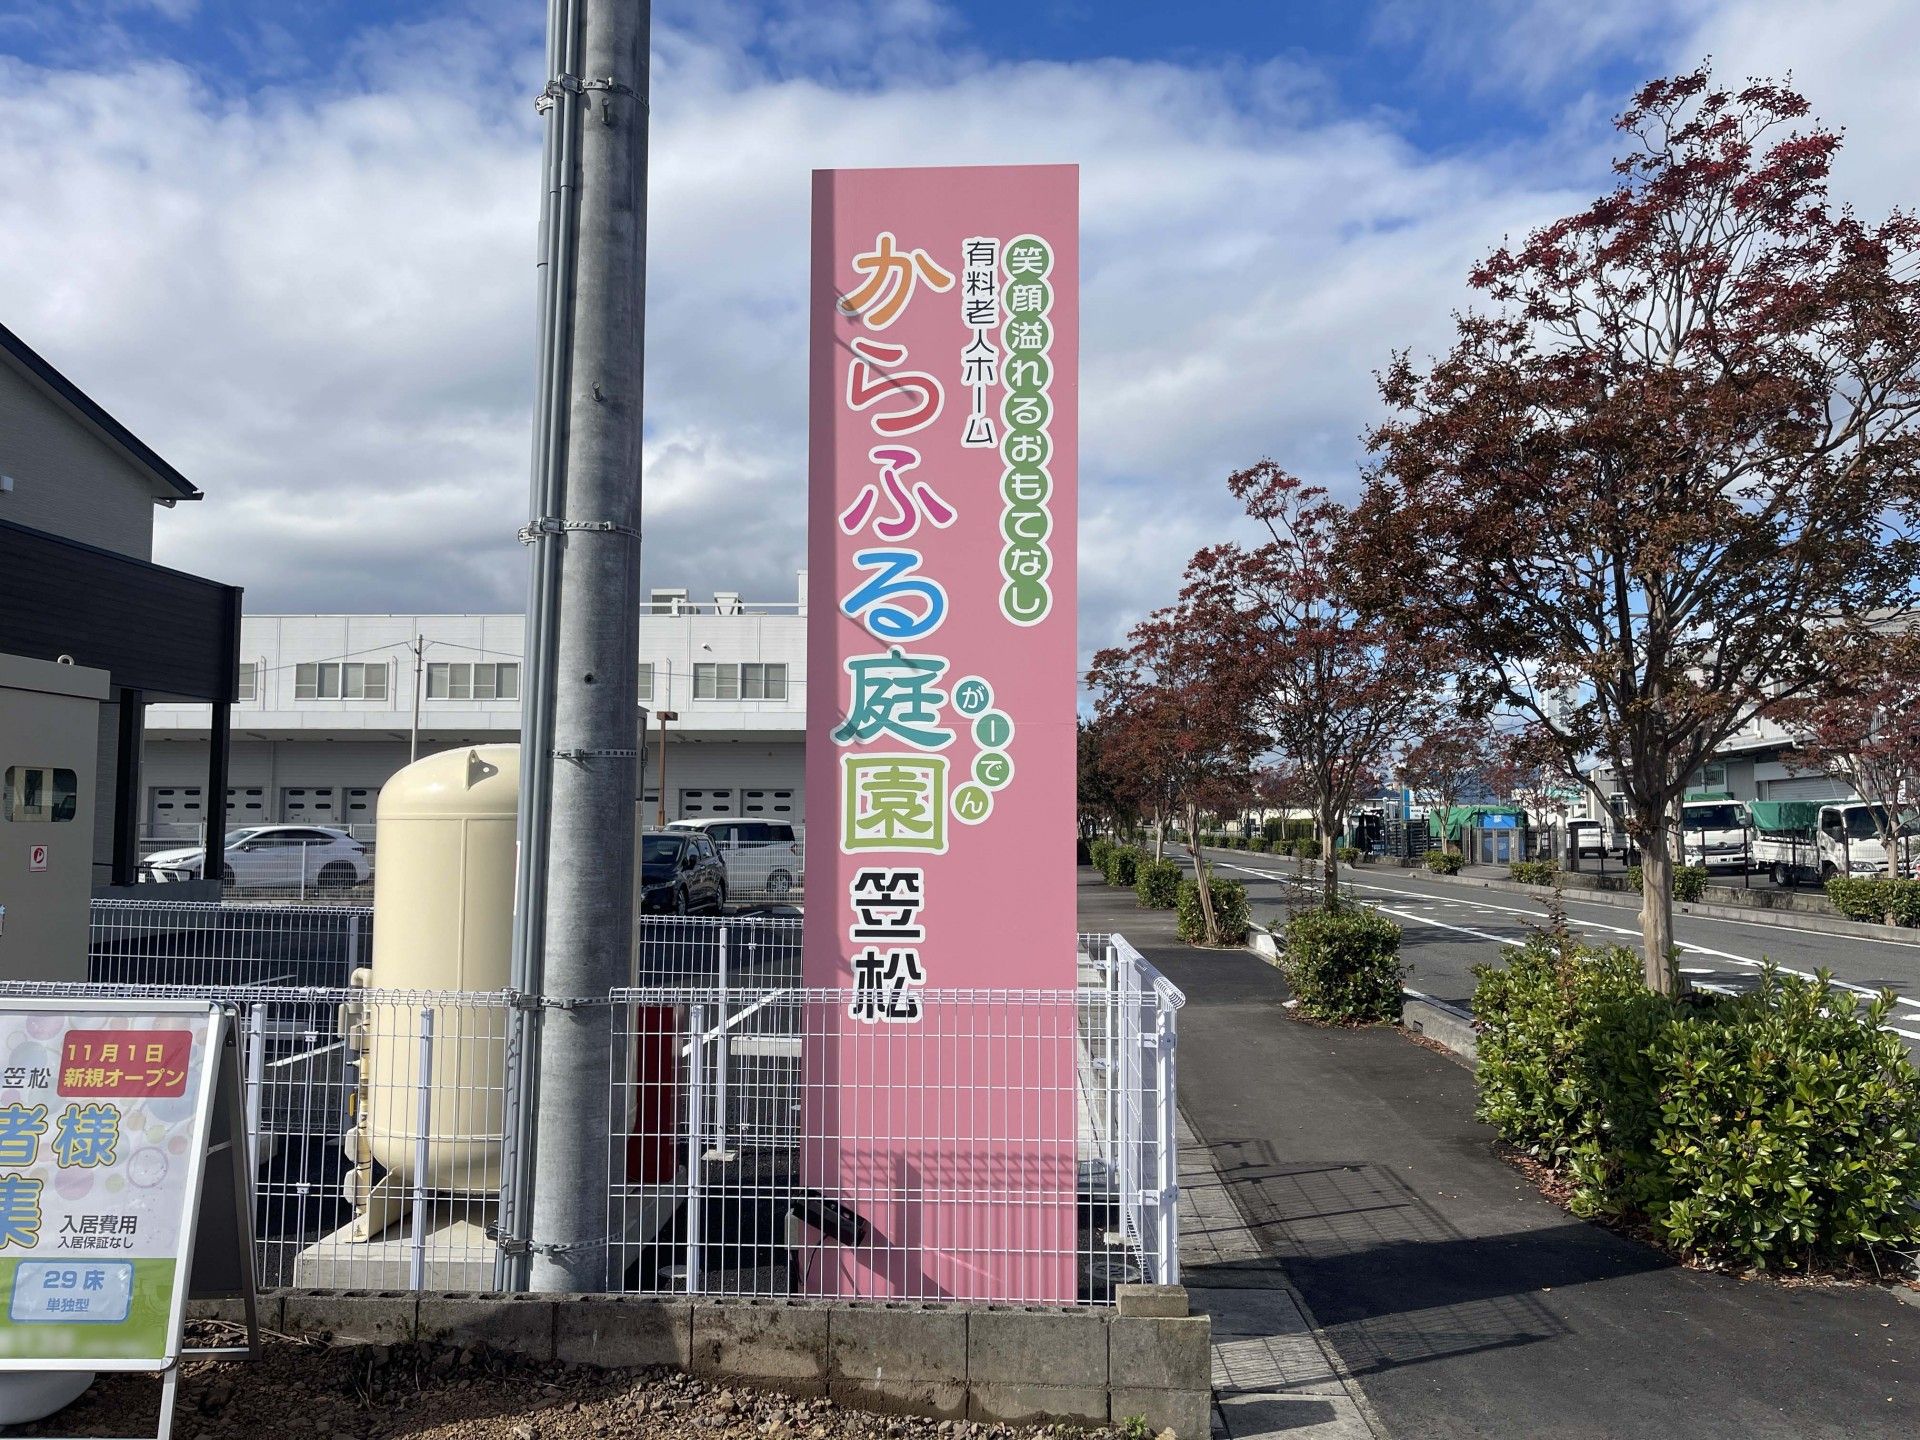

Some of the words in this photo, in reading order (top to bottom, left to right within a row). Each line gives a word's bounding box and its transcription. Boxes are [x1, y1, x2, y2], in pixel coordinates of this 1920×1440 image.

[964, 239, 998, 445] 有料老人ホーム
[1006, 242, 1049, 619] 笑顔溢れるおもてなし
[832, 233, 956, 854] からふる庭園
[957, 682, 1008, 816] がーでん
[851, 870, 925, 1022] 笠松
[2, 1066, 52, 1090] 笠松
[63, 1067, 185, 1089] 新規オープン
[57, 1235, 134, 1250] 入居保証なし
[59, 1214, 138, 1236] 入居費用
[45, 1297, 90, 1314] 単独型
